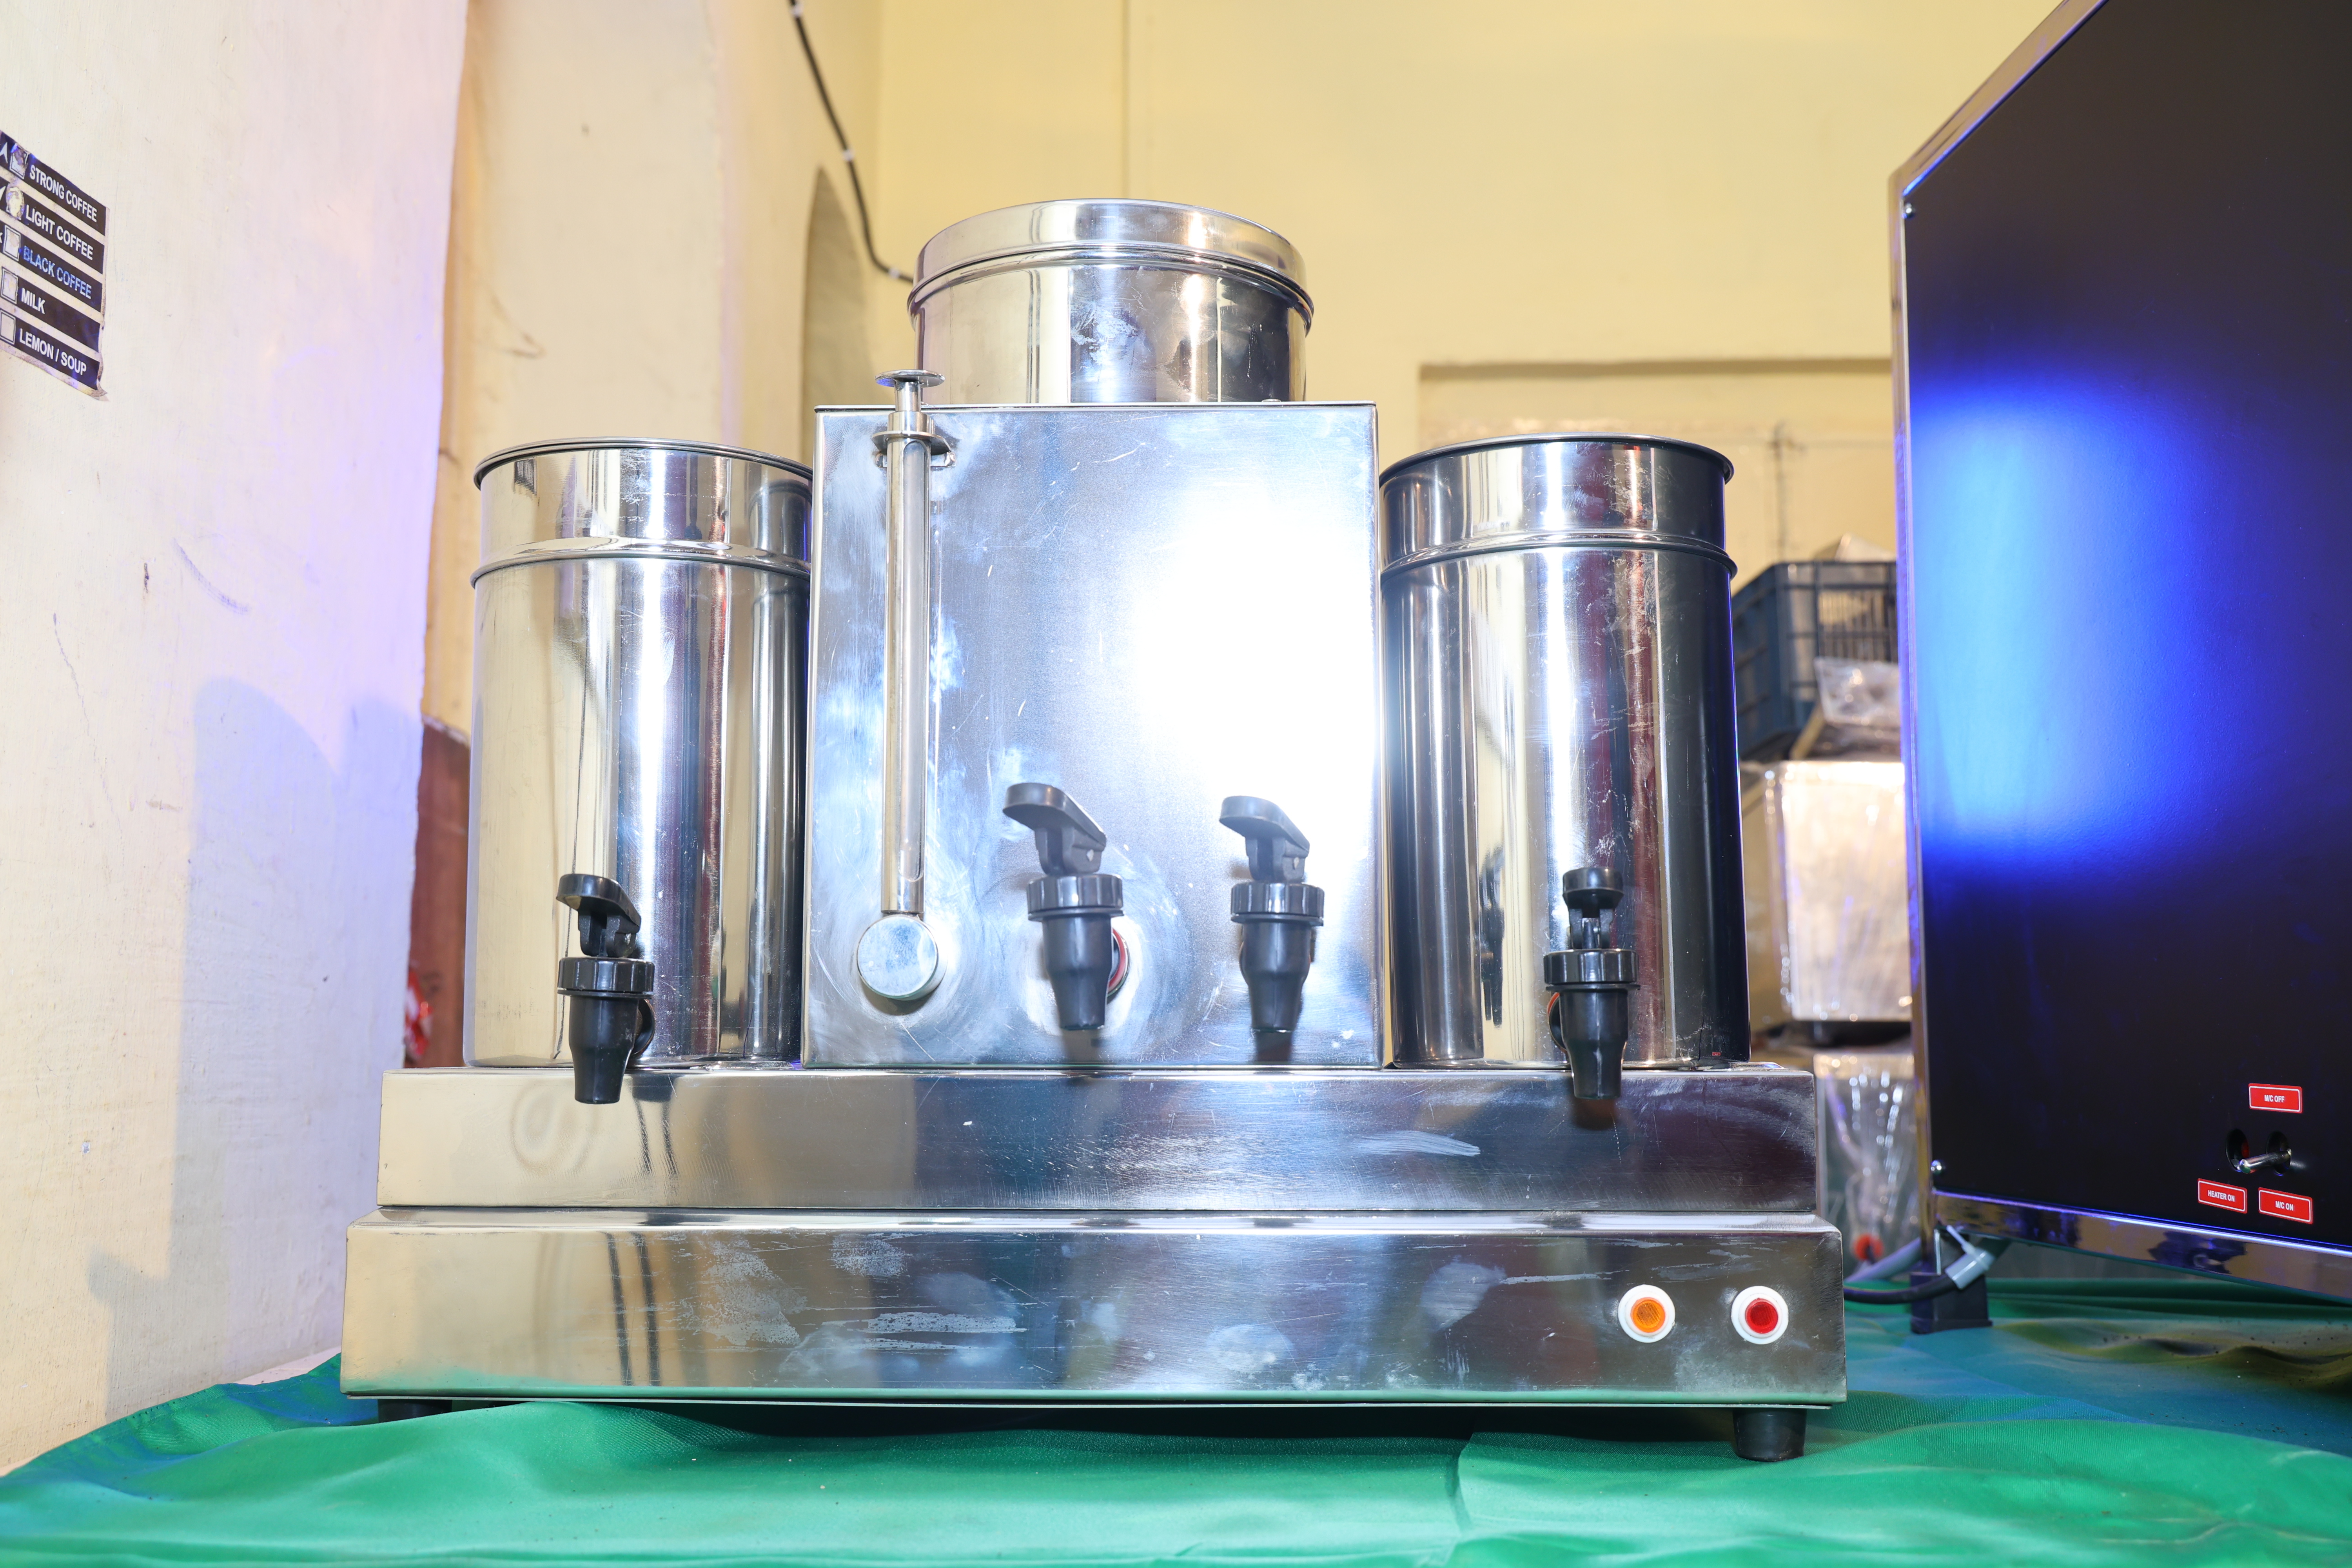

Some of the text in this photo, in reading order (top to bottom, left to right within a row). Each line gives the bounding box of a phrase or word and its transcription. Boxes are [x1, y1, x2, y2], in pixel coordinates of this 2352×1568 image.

[29, 164, 97, 223] STRONG COFFEE
[25, 204, 93, 261] LIGHT COFFEE
[23, 245, 92, 299] BLACK COFFEE
[21, 287, 45, 314] MILK
[20, 328, 87, 376] LEMON / SOUP
[2208, 1190, 2227, 1200] HEATER
[2275, 1200, 2293, 1211] M/C ON
